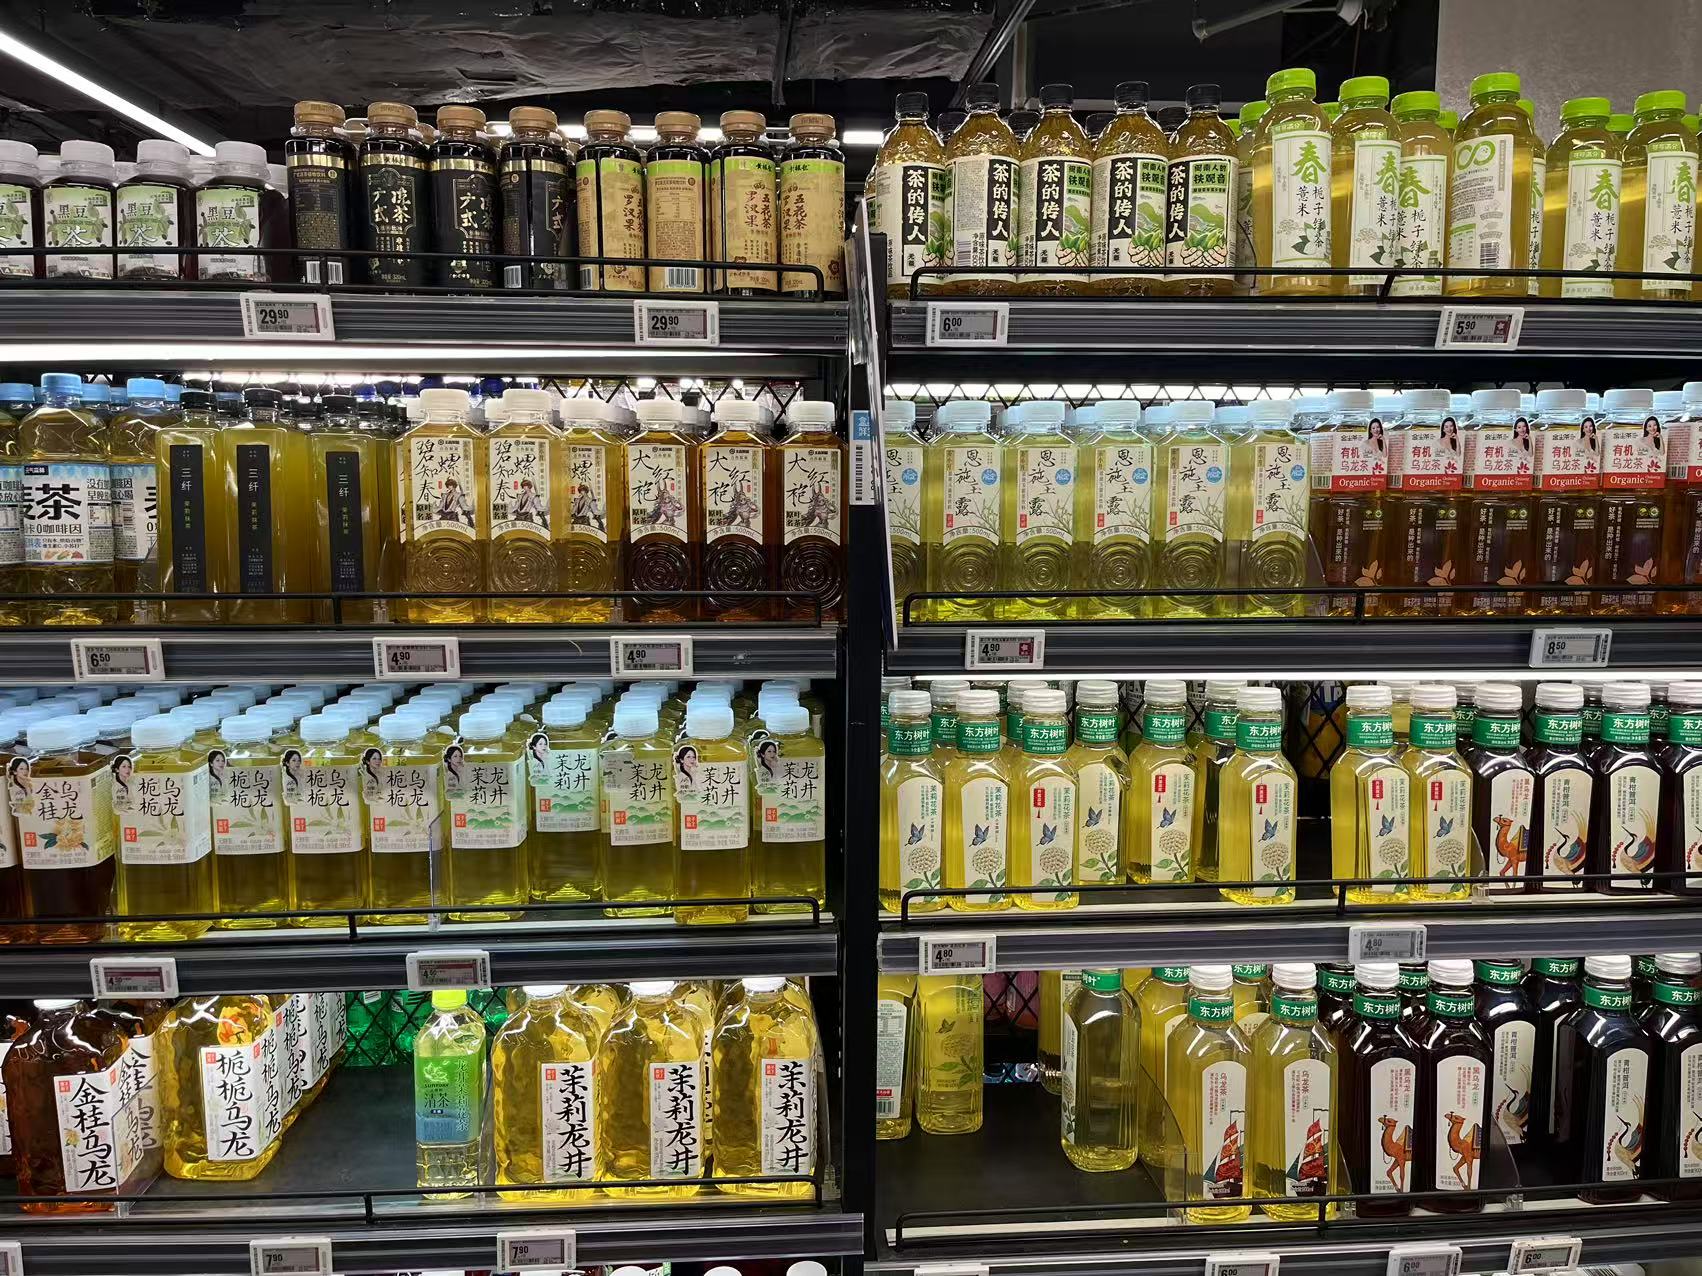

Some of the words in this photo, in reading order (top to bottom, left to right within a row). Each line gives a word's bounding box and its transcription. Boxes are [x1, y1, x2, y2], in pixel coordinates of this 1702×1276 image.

[1290, 140, 1327, 185] 春
[1193, 173, 1226, 184] 铁观音
[1374, 151, 1400, 197] 春
[1399, 165, 1432, 209] 春
[1586, 169, 1619, 212] 春
[1669, 161, 1697, 204] 春
[906, 169, 927, 242] 茶的传人
[991, 163, 1009, 238] 茶的传人
[1040, 163, 1061, 238] 茶的传人
[1113, 160, 1134, 237] 茶的传人
[1168, 165, 1186, 239] 茶的传人
[1296, 186, 1310, 217] 薏米
[58, 203, 89, 219] 黑豆
[127, 202, 154, 217] 黑豆
[207, 206, 236, 221] 黑豆
[745, 191, 759, 228] 罗汉果
[782, 195, 792, 231] 罗汉果
[793, 193, 808, 230] 五花茶
[63, 226, 92, 248] 茶
[127, 225, 157, 248] 茶
[212, 227, 240, 248] 茶
[259, 309, 289, 326] 29.90
[651, 315, 679, 331] 29.90
[943, 316, 962, 332] 6.00
[1455, 320, 1476, 335] 5.90
[1340, 447, 1360, 459] 有机
[1411, 446, 1431, 458] 有机
[1484, 446, 1504, 458] 有机
[1551, 446, 1572, 457] 有机
[1612, 444, 1634, 457] 有机
[1340, 459, 1369, 472] 乌龙茶
[1411, 458, 1441, 471] 乌龙茶
[1483, 458, 1514, 471] 乌龙茶
[1552, 458, 1581, 471] 乌龙茶
[1612, 457, 1643, 470] 乌龙茶
[181, 468, 192, 491] 三纤
[248, 468, 259, 492] 三纤
[630, 449, 674, 504] 大红袍
[707, 451, 751, 506] 大红袍
[785, 452, 830, 507] 大红袍
[954, 449, 982, 517] 恩施玉露
[1028, 449, 1056, 517] 恩施玉露
[1105, 448, 1134, 516] 恩施玉露
[1178, 447, 1208, 514] 恩施玉露
[1264, 445, 1292, 513] 恩施玉露
[1339, 478, 1370, 488] Organic
[1409, 477, 1442, 488] Organic
[1481, 477, 1515, 487] Organic
[1550, 476, 1582, 487] Organic
[1609, 474, 1645, 485] Organic
[338, 474, 350, 497] 三纤
[627, 649, 646, 663] 4.90
[981, 643, 1000, 656] 4.90
[1547, 641, 1566, 655] 8.50
[90, 653, 111, 668] 6.50
[390, 650, 410, 666] 4.90
[1080, 717, 1116, 728] 东方树叶
[1152, 717, 1185, 728] 东方树叶
[894, 730, 930, 741] 东方树叶
[964, 727, 999, 737] 东方树叶
[1030, 728, 1065, 739] 东方树叶
[1364, 938, 1383, 951] 4.80
[935, 949, 953, 963] 4.80
[216, 1051, 255, 1158] 栀栀乌龙
[424, 1092, 450, 1108] 清茶
[555, 1065, 592, 1180] 茉莉龙井
[664, 1065, 699, 1176] 茉莉龙井
[774, 1061, 809, 1176] 茉莉龙井
[70, 1077, 117, 1189] 金桂乌龙
[511, 1244, 529, 1259] 7.90
[1525, 1252, 1544, 1265] 6.00
[265, 1253, 283, 1272] 7.90
[1403, 1261, 1421, 1273] 6.00
